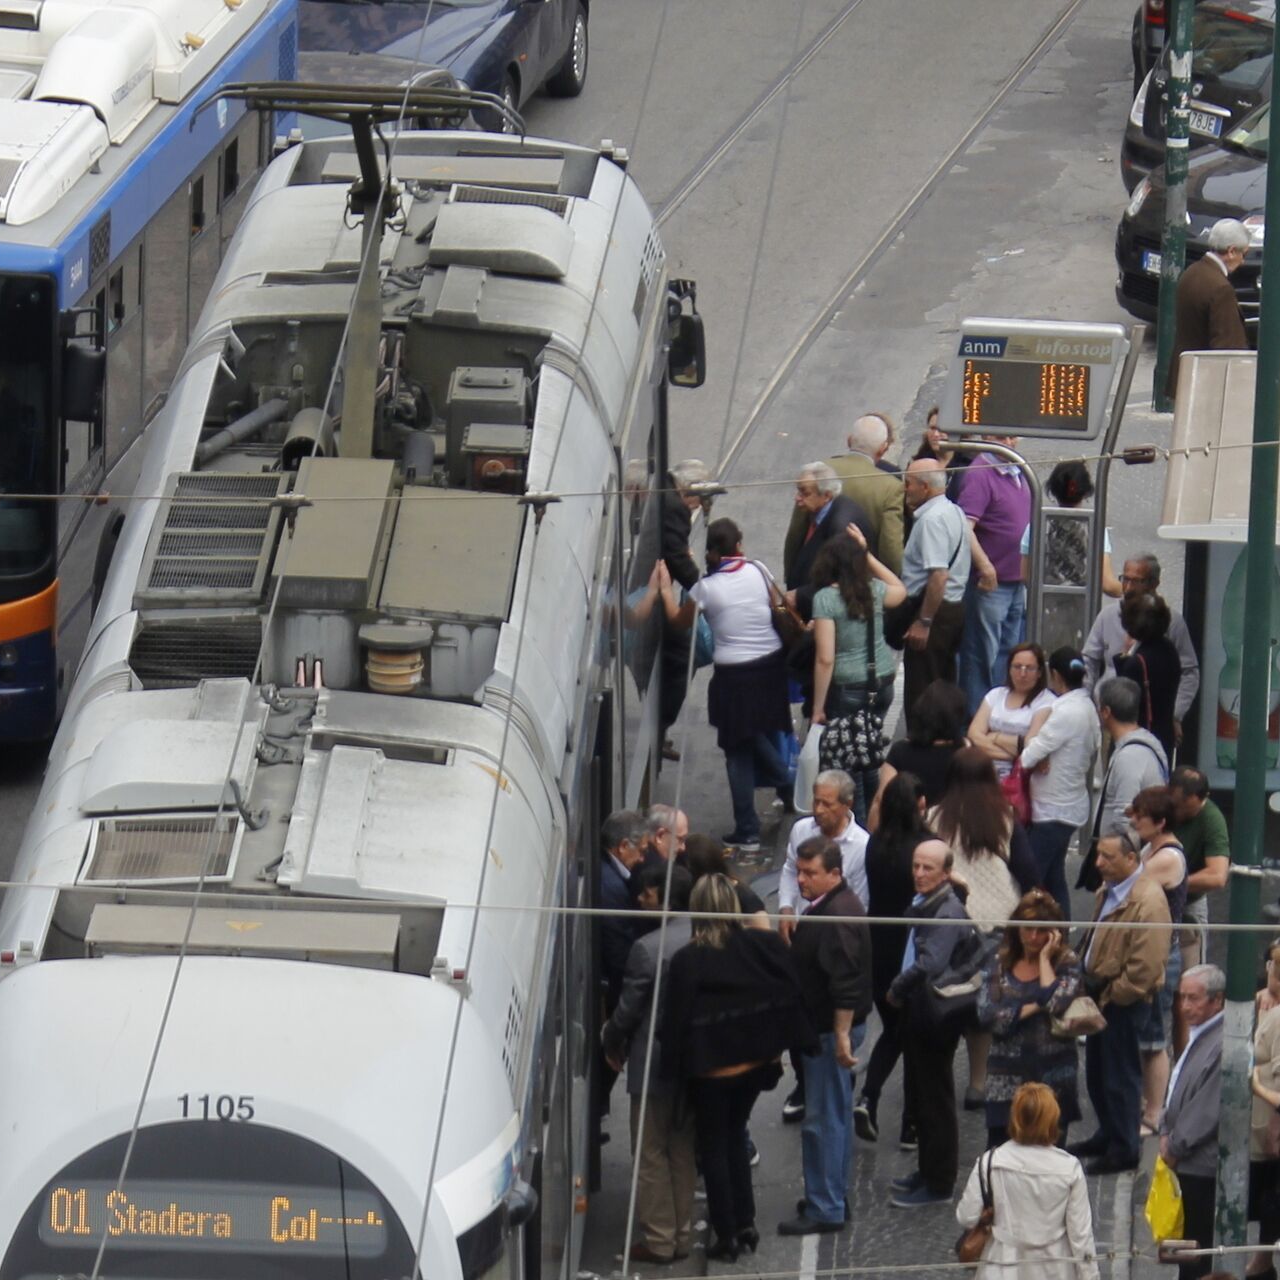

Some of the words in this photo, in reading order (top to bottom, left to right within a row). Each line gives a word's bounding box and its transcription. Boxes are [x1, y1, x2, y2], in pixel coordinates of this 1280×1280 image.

[1190, 112, 1215, 132] 78JE
[964, 341, 1001, 354] anm
[1035, 338, 1111, 358] infostop
[177, 1093, 256, 1121] 1105
[51, 1187, 91, 1236] 01
[107, 1189, 233, 1239] Stadera
